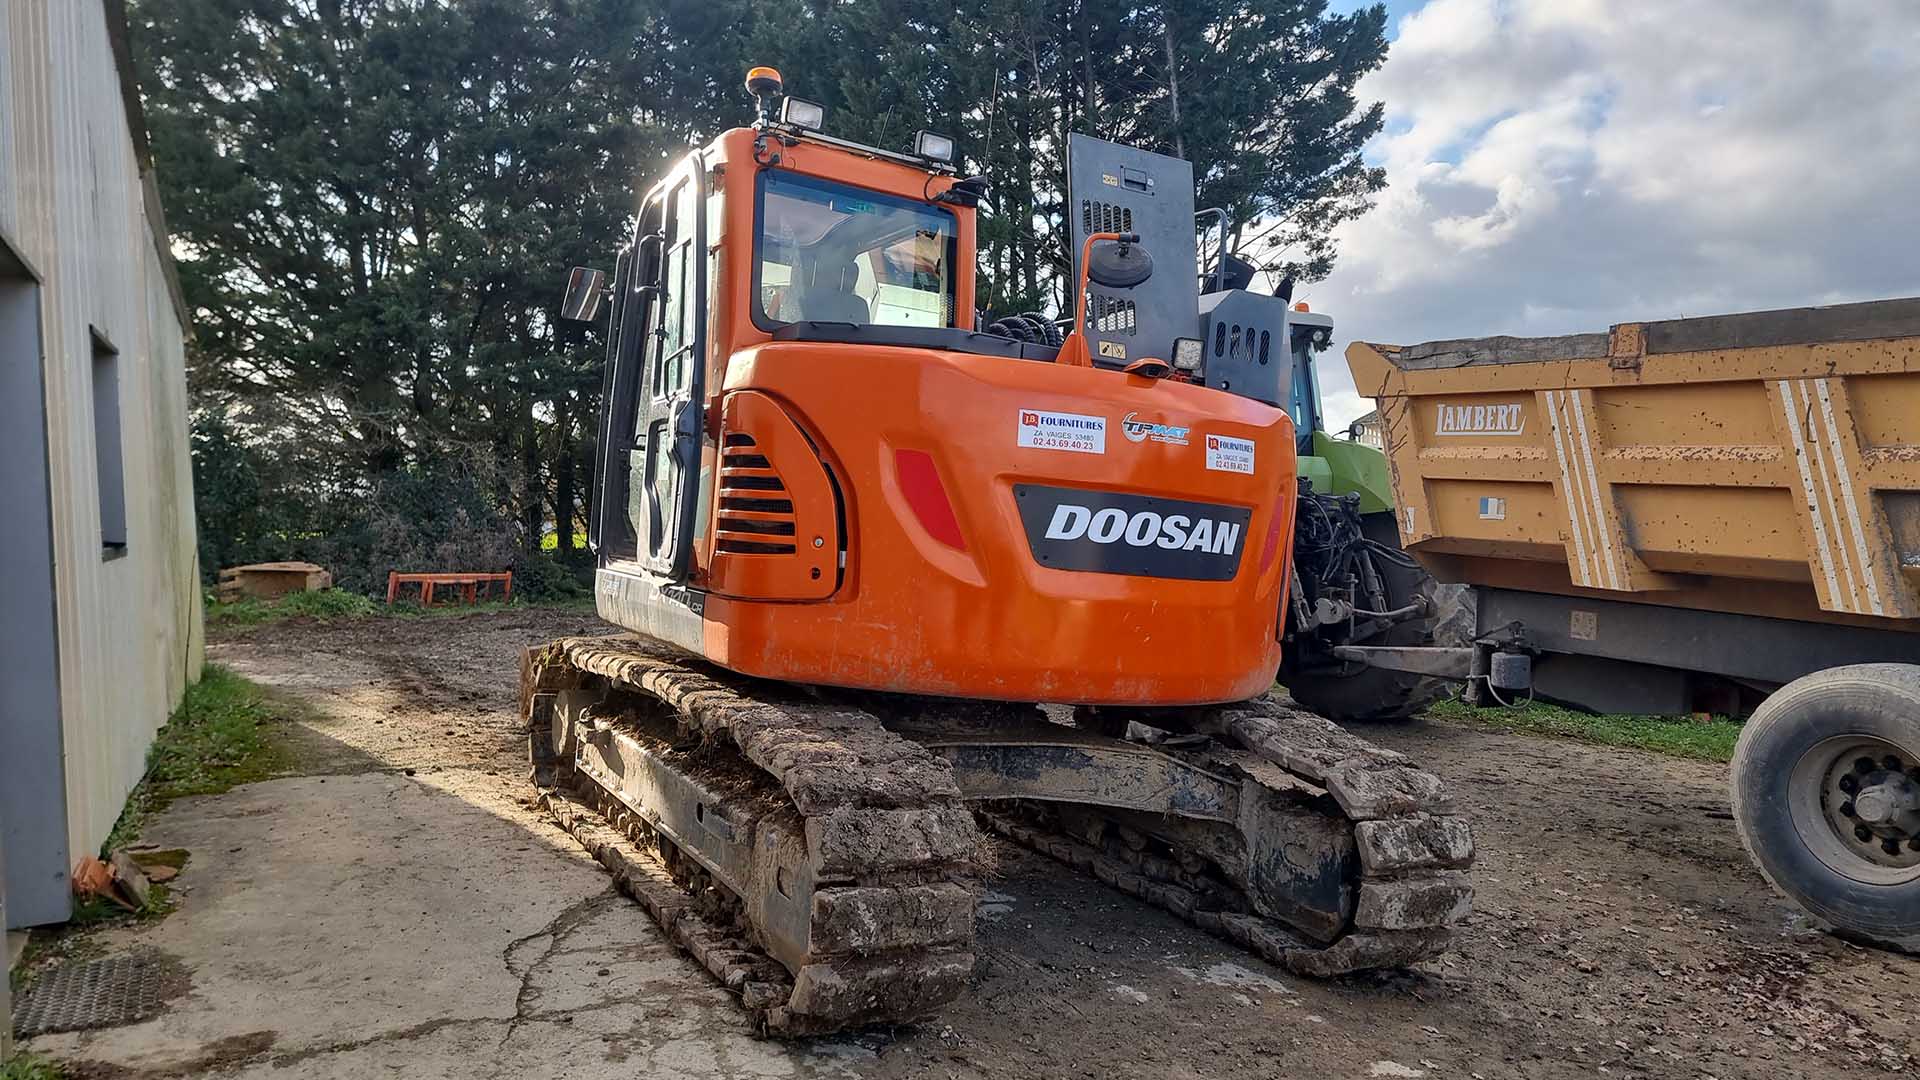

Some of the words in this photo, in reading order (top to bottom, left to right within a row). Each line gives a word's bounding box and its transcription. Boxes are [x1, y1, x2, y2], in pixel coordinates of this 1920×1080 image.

[1041, 416, 1103, 430] FOURNITURES
[1435, 404, 1526, 435] LAMBERT
[1033, 437, 1094, 450] 02.43.69.40.23
[1045, 504, 1240, 555] DOOSAN
